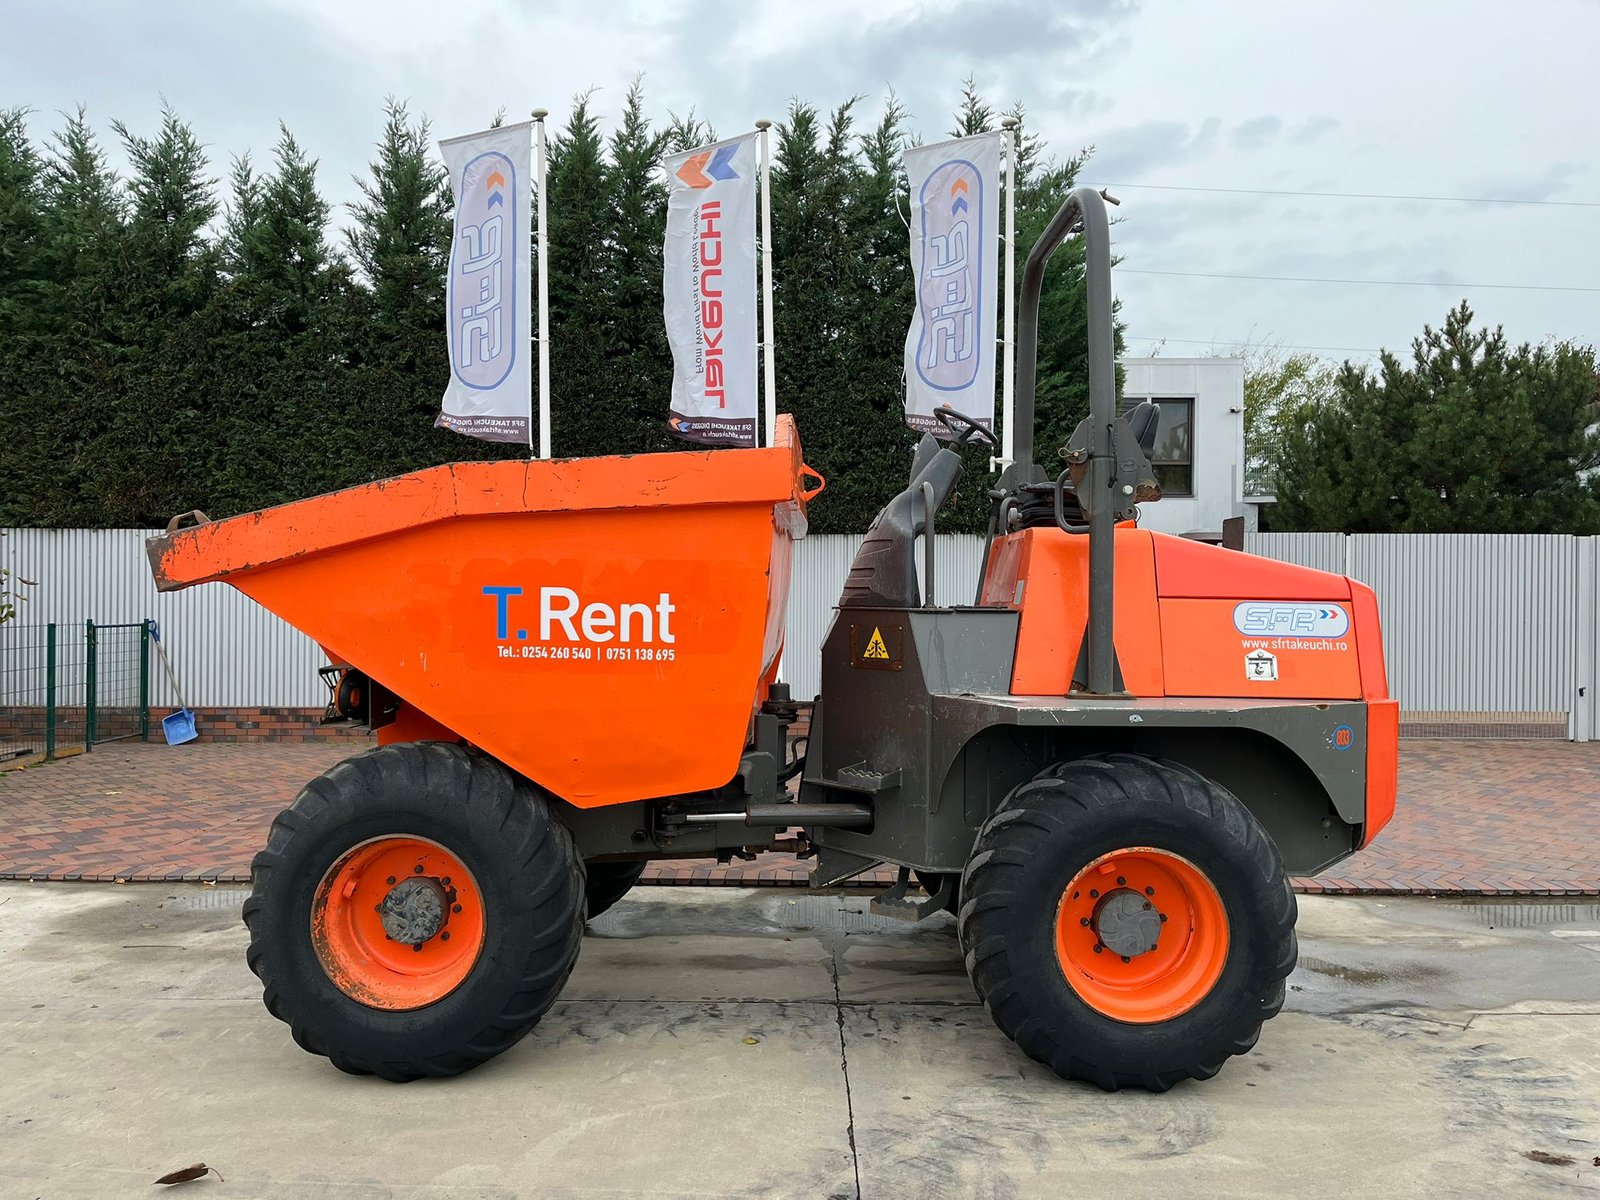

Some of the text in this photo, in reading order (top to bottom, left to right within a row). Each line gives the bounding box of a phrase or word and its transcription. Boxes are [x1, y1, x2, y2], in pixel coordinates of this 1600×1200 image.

[482, 586, 676, 643] T. Rent
[1244, 607, 1317, 631] SFR
[497, 645, 519, 658] Tel.:
[522, 646, 548, 658] 0254
[550, 647, 570, 659] 260
[572, 648, 591, 659] 540
[606, 648, 631, 660] 0751
[635, 649, 653, 660] 138
[656, 649, 675, 661] 695
[1241, 638, 1348, 651] www.sfrtakeuchi.ro
